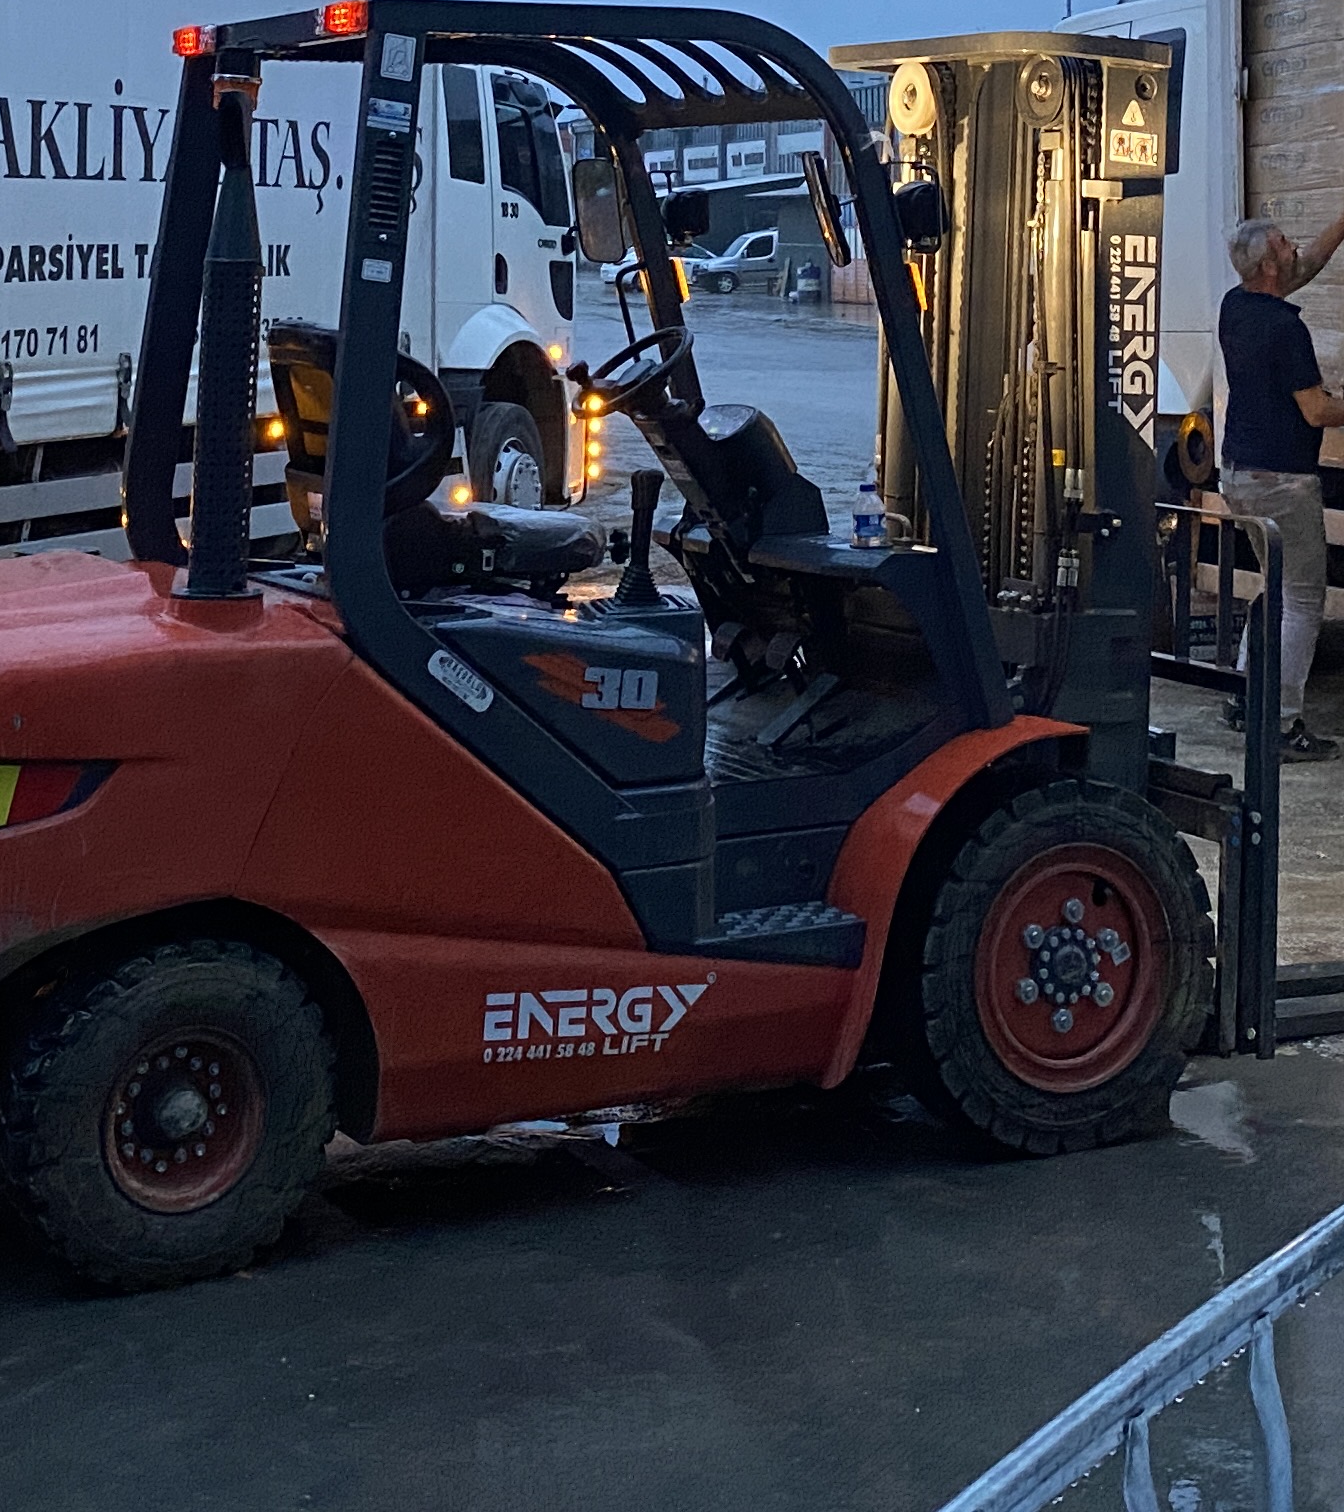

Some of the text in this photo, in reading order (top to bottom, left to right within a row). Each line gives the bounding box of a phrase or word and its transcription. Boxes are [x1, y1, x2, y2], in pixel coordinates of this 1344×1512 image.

[1, 328, 38, 360] 170
[46, 325, 68, 356] 71
[77, 323, 99, 354] 81
[1122, 234, 1158, 451] ENERGY
[1107, 349, 1122, 415] LIFT
[581, 666, 660, 710] 30
[483, 983, 709, 1041] ENERGY
[483, 1033, 670, 1064] 0 224 441 58 48 LIFT
